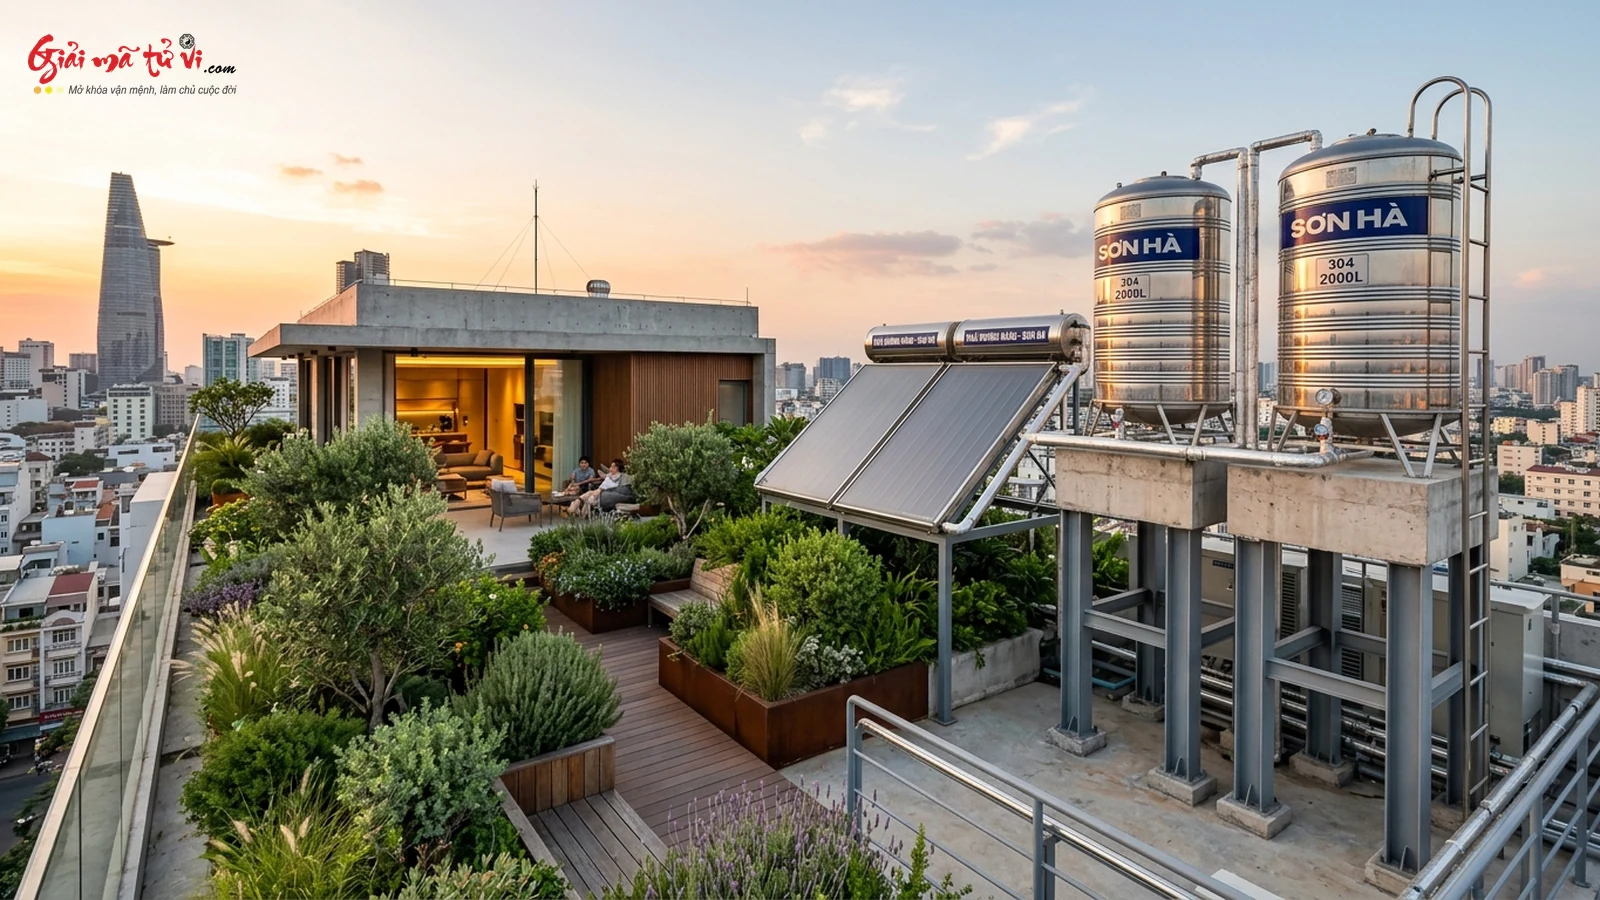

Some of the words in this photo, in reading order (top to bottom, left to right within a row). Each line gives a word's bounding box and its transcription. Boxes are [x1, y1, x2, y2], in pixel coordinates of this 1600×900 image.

[1291, 211, 1350, 238] SƠN
[1357, 202, 1408, 229] HÀ
[1098, 239, 1139, 261] SƠN
[1143, 232, 1182, 254] HÀ
[1328, 257, 1354, 270] 304
[1320, 271, 1363, 285] 2000L
[1115, 289, 1147, 300] 2000L
